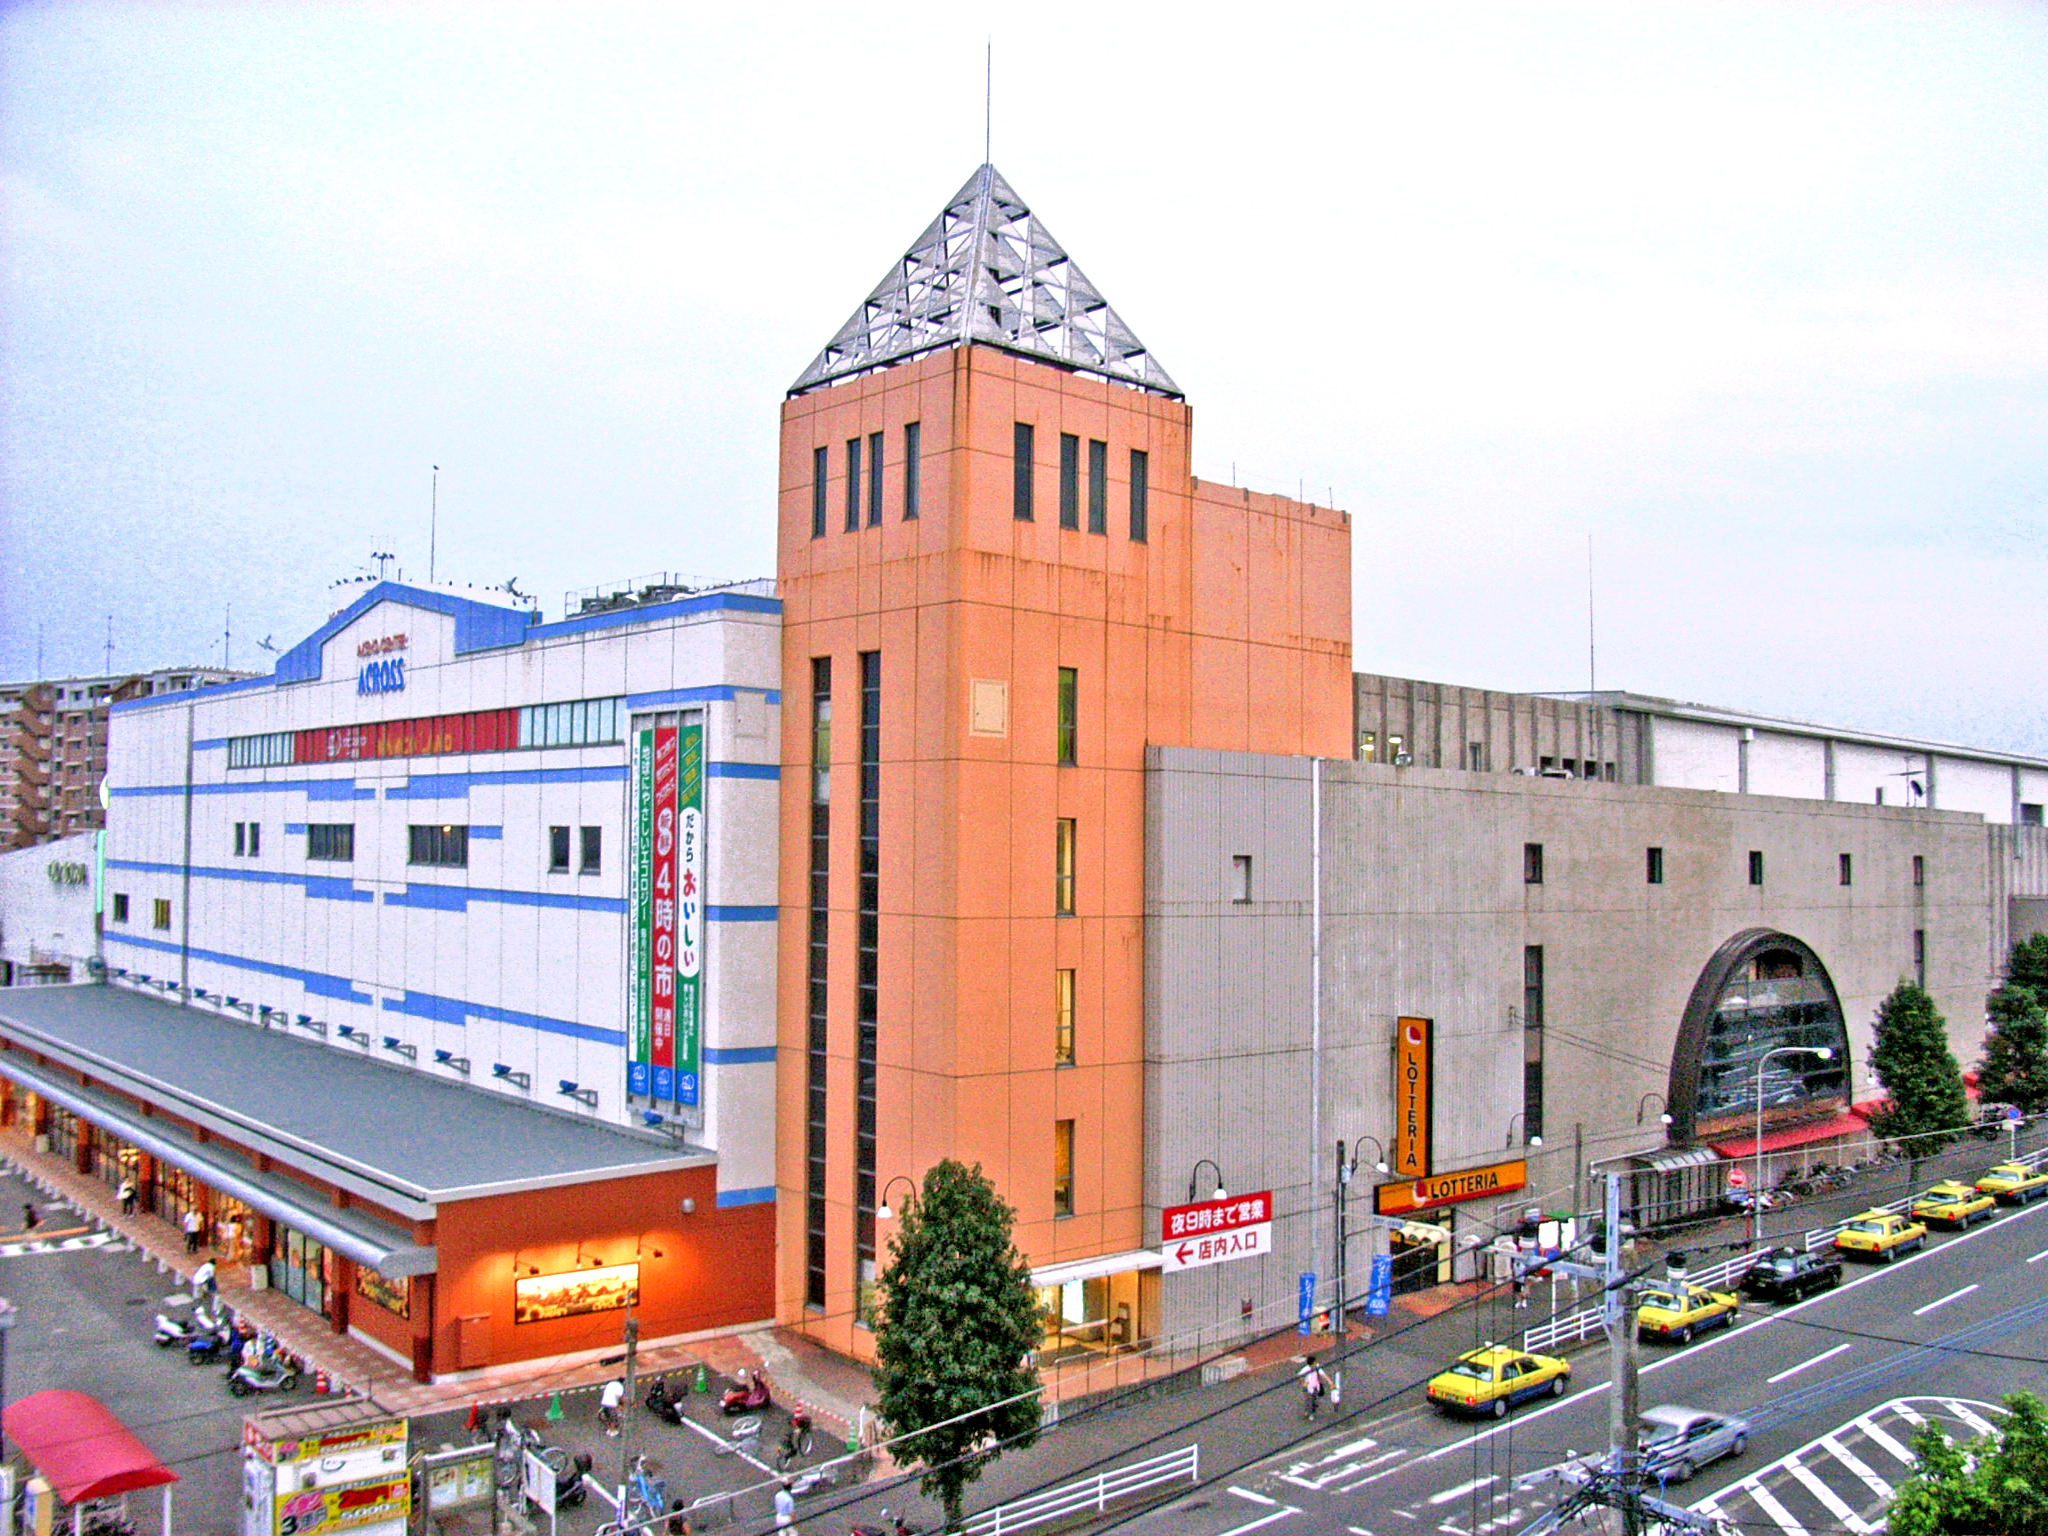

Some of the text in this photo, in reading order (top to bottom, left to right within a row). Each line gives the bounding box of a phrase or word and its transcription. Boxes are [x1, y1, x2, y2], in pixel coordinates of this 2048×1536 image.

[358, 656, 405, 694] ACROSS
[1406, 1052, 1418, 1167] LOTTERIA
[1430, 1172, 1499, 1199] LOTTERIA
[1171, 1199, 1265, 1235] 夜9時まで営業
[1198, 1231, 1257, 1260] 店内入口
